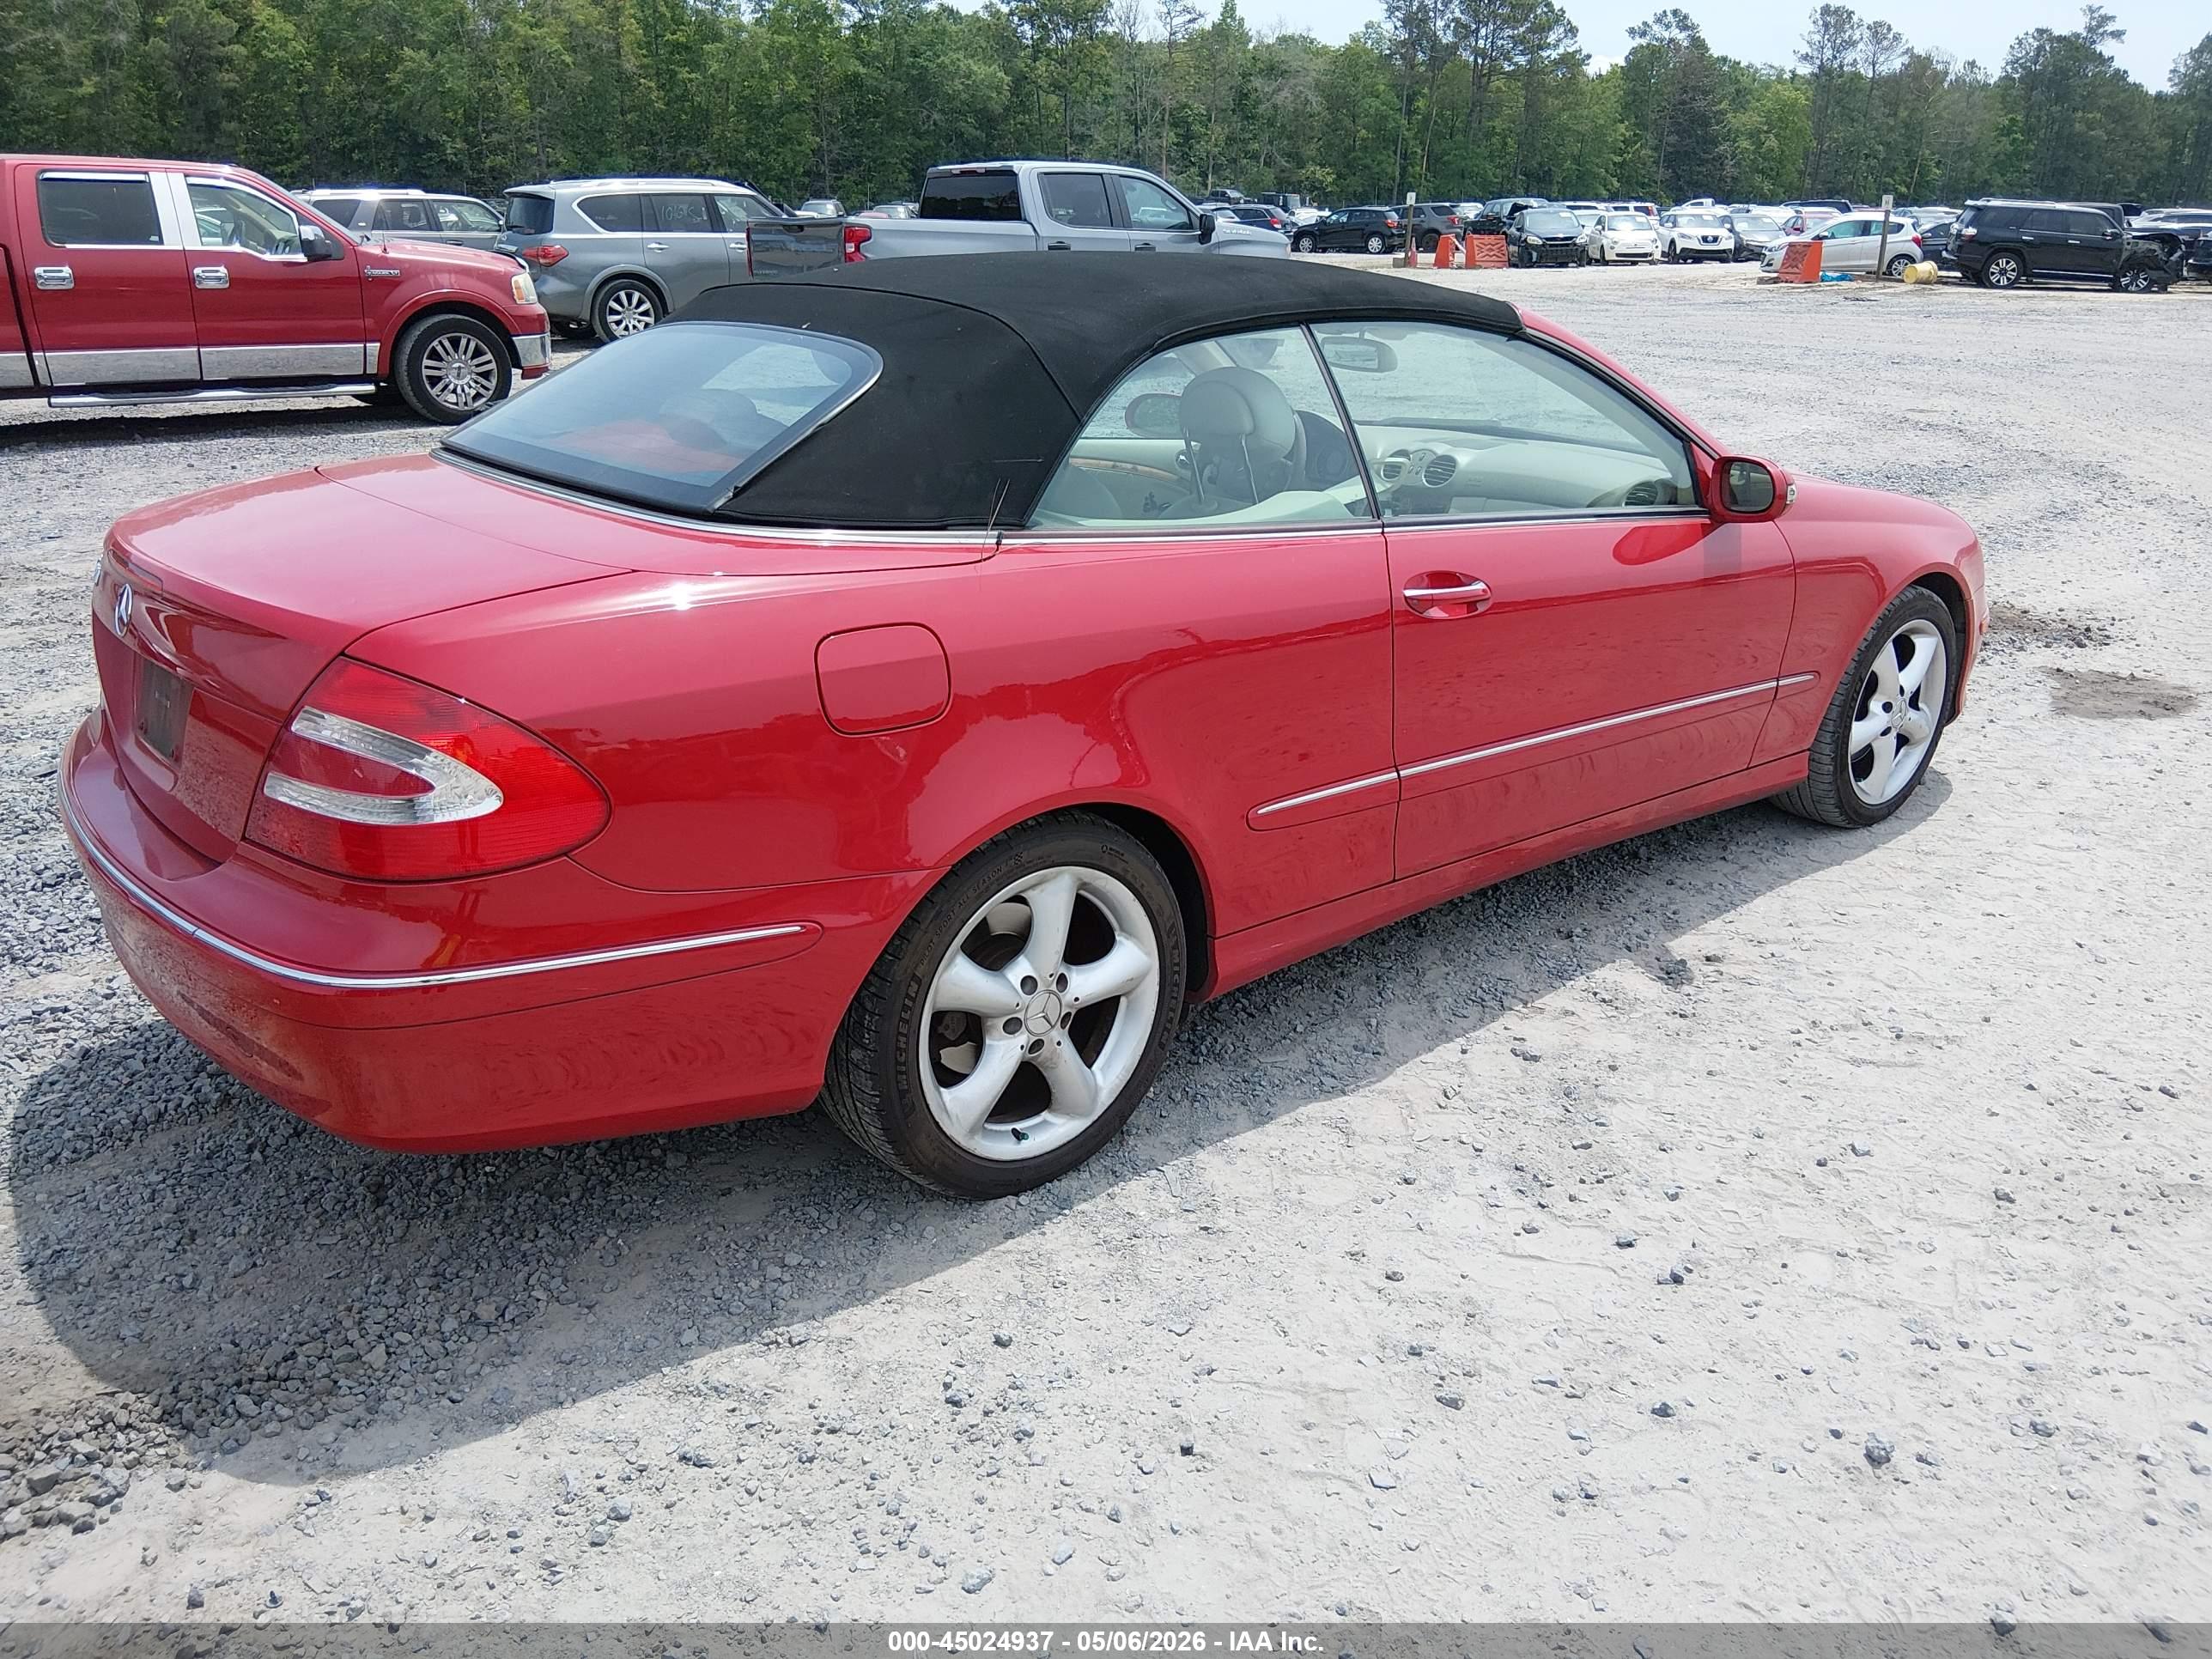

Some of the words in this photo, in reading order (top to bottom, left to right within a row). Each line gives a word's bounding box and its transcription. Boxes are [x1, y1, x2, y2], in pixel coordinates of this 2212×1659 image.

[935, 908, 957, 939] SPORT
[957, 895, 970, 911] ALL
[971, 866, 1004, 894] SEASON
[896, 978, 921, 1091] MICHELIN
